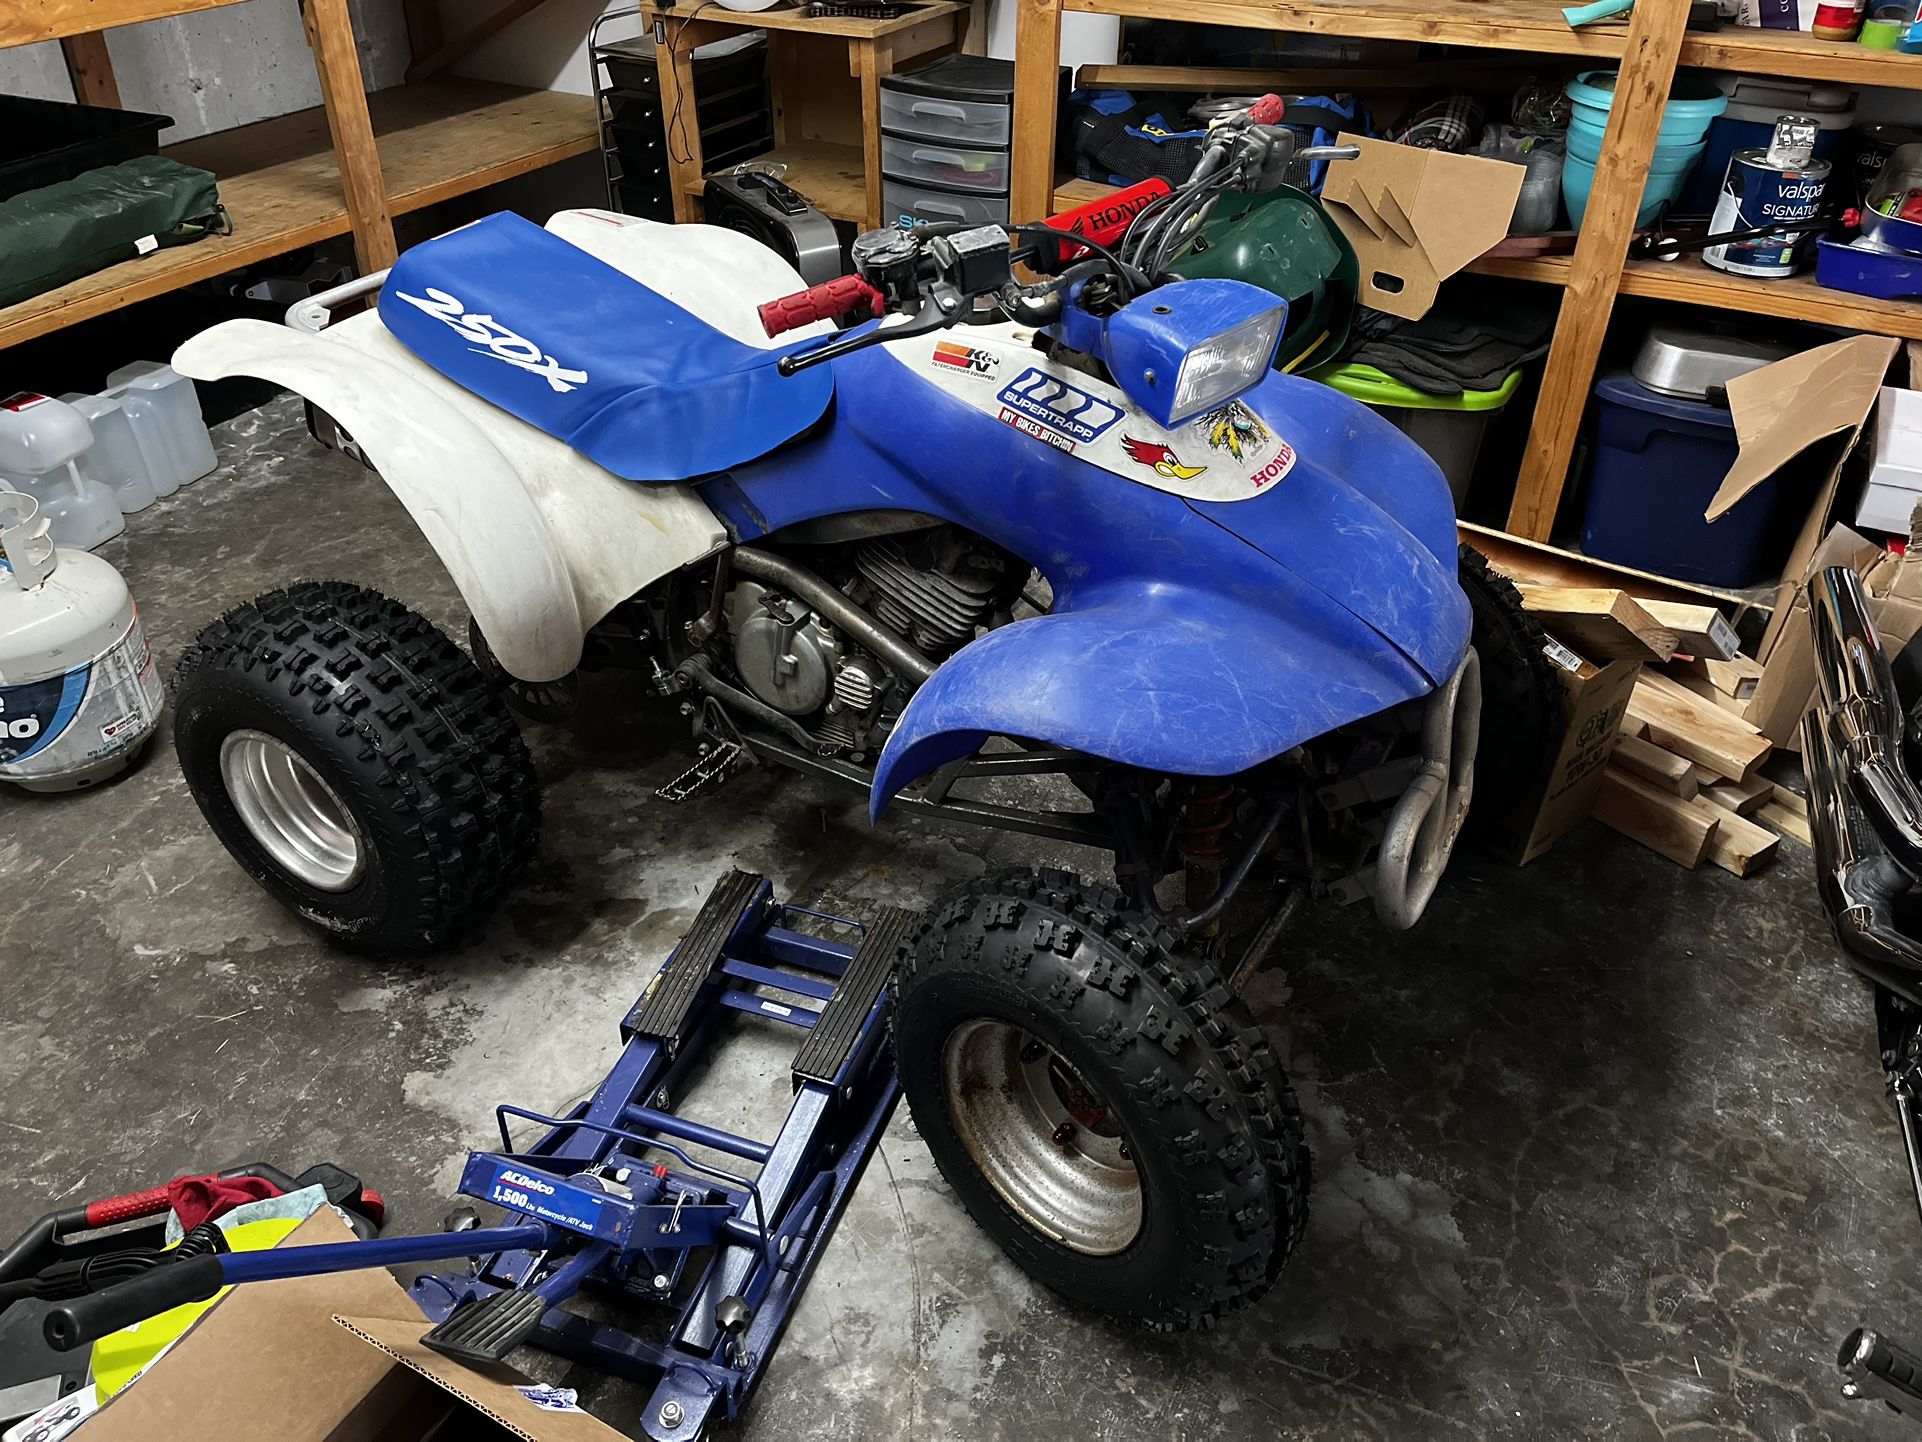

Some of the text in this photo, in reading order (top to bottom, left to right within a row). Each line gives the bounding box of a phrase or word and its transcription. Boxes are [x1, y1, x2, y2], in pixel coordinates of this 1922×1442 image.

[1088, 191, 1160, 230] HONDA
[931, 361, 996, 381] FILTERCHARGER EQUIPPED
[1001, 409, 1074, 451] MY BIKES BITCHIN
[1003, 391, 1094, 439] SUPERTRAPP
[1250, 443, 1292, 488] HONDA
[500, 1170, 556, 1196] ACDelco
[492, 1186, 528, 1208] 1,500
[536, 1206, 567, 1221] Motorcycle
[579, 1221, 593, 1231] Jack
